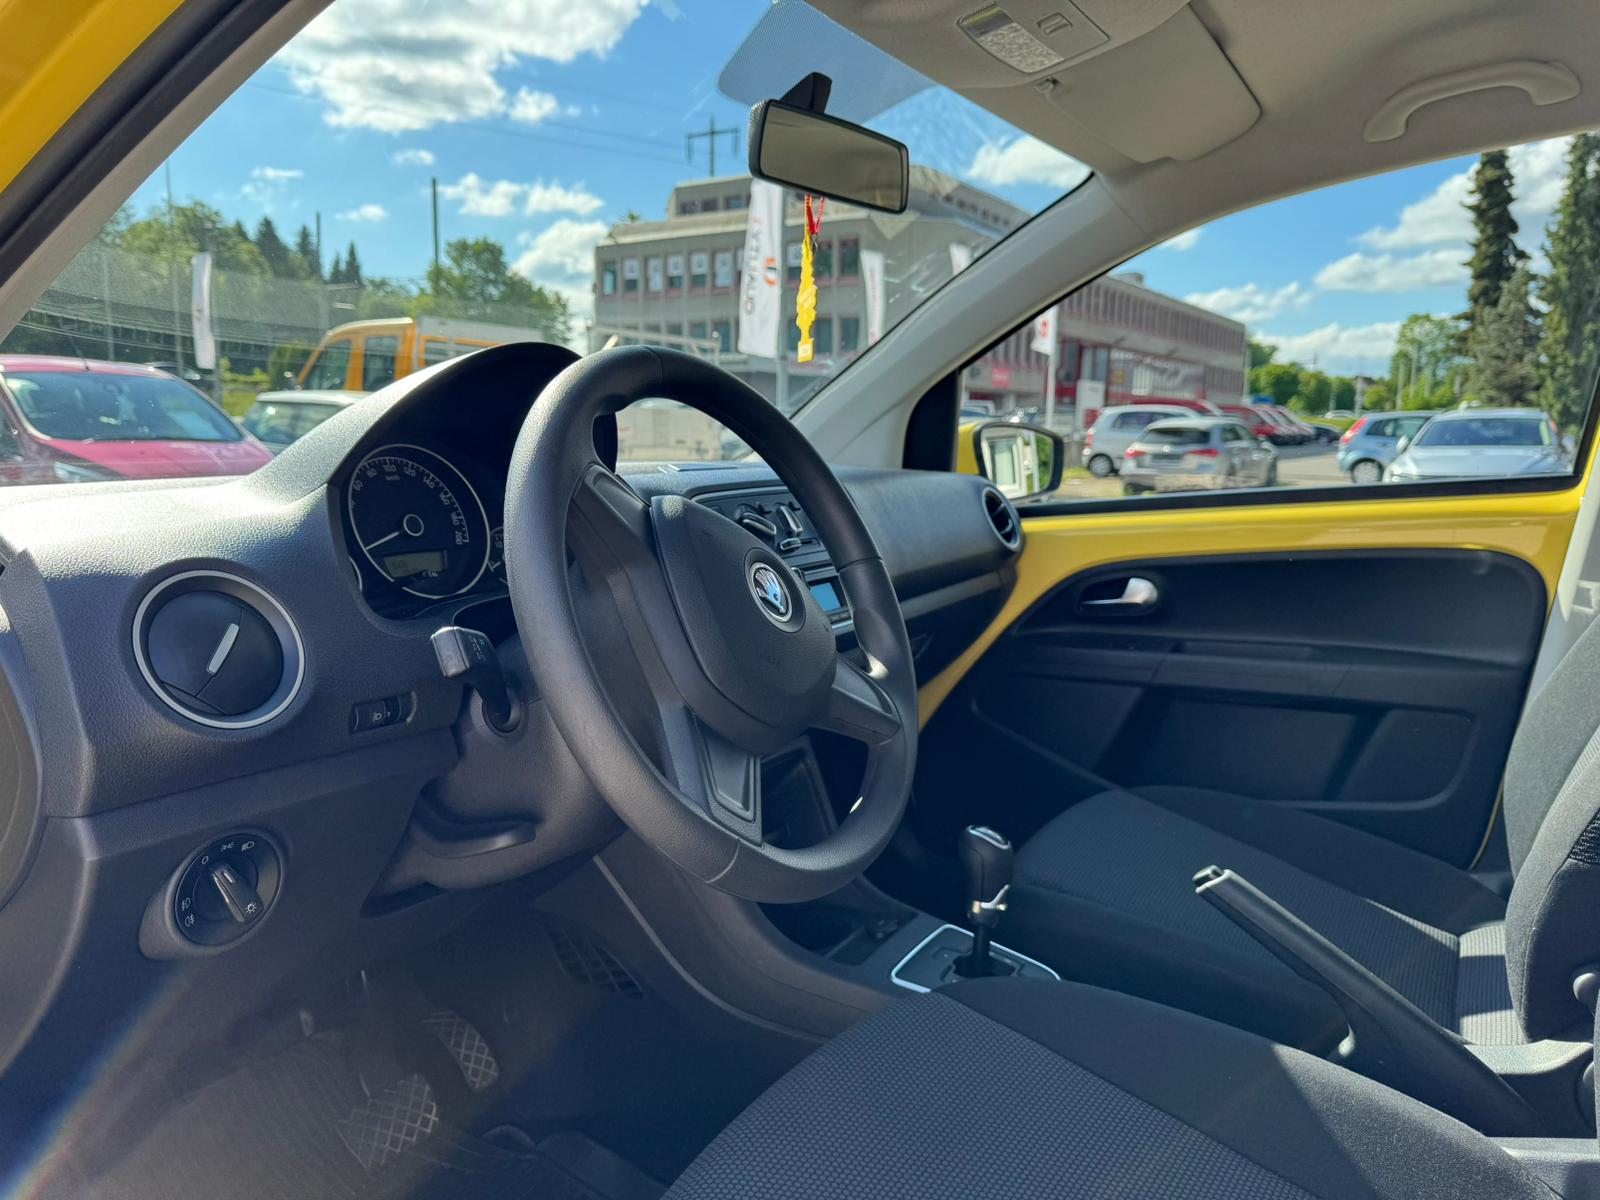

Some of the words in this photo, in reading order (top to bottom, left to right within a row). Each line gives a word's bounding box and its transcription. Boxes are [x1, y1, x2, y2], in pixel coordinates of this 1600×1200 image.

[383, 464, 397, 472] 100
[403, 467, 416, 477] 120
[424, 476, 436, 488] 140
[455, 530, 463, 545] 200
